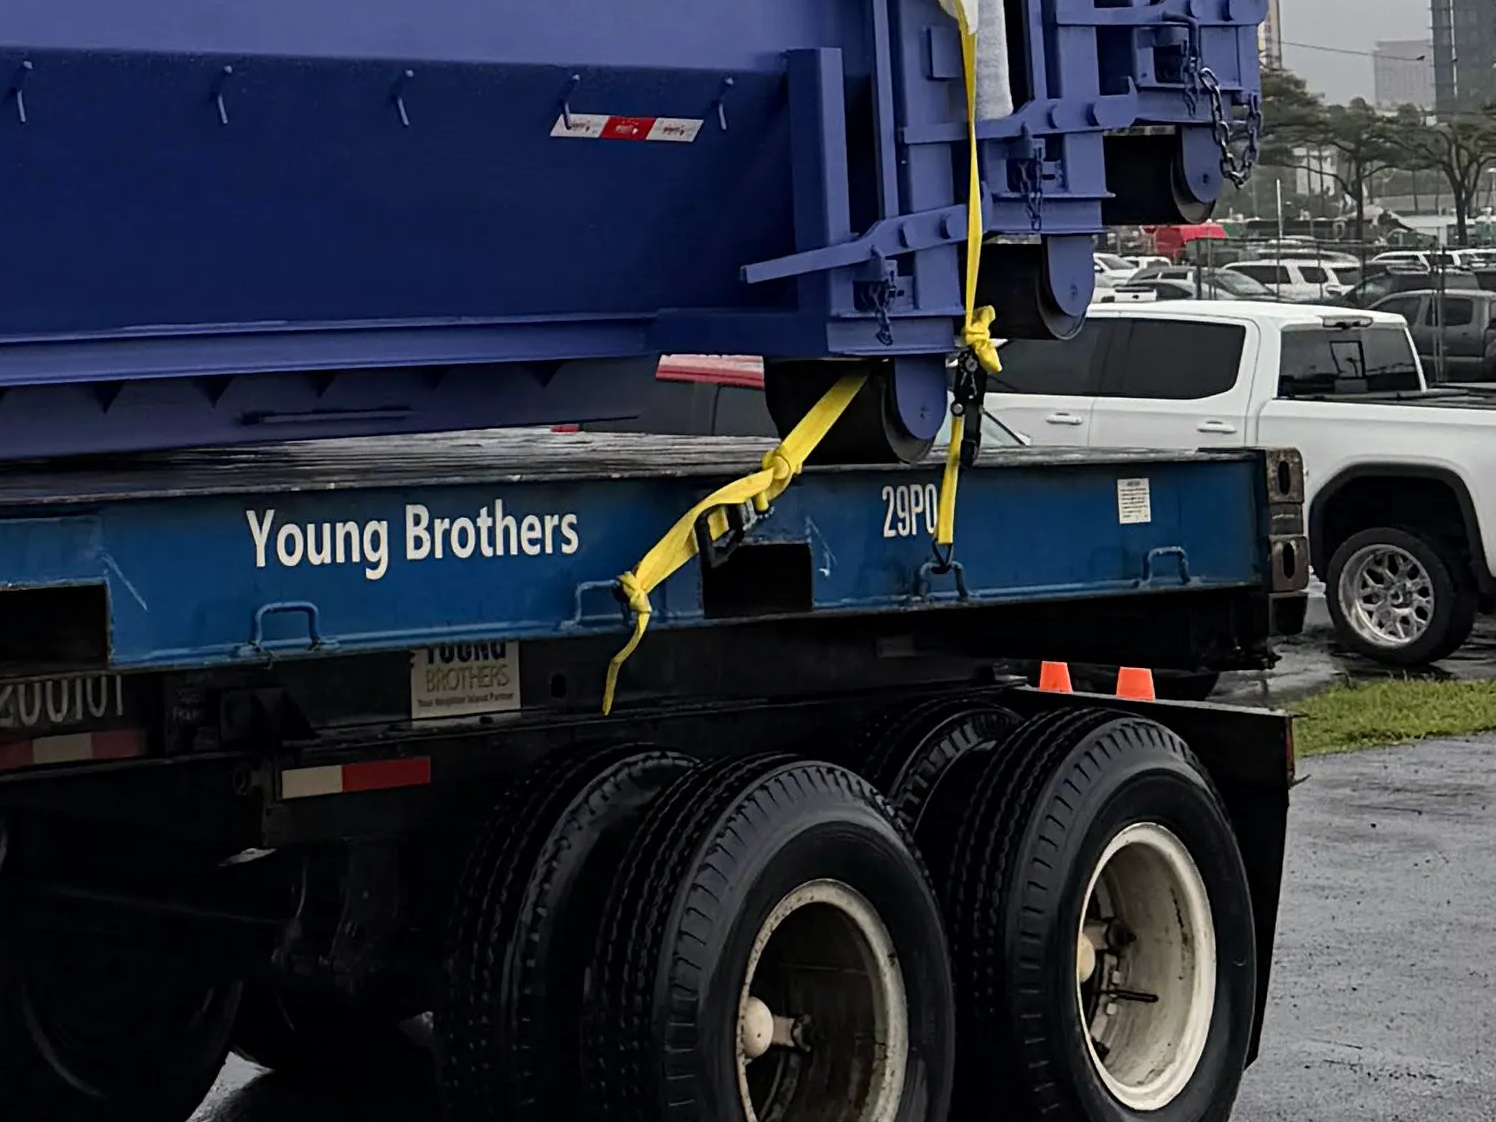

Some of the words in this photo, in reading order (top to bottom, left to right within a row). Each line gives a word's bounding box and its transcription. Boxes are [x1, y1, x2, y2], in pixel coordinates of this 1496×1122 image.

[882, 483, 937, 538] 29P0
[246, 509, 388, 580] Young
[406, 499, 579, 560] Brothers
[425, 663, 510, 694] BROTHERS
